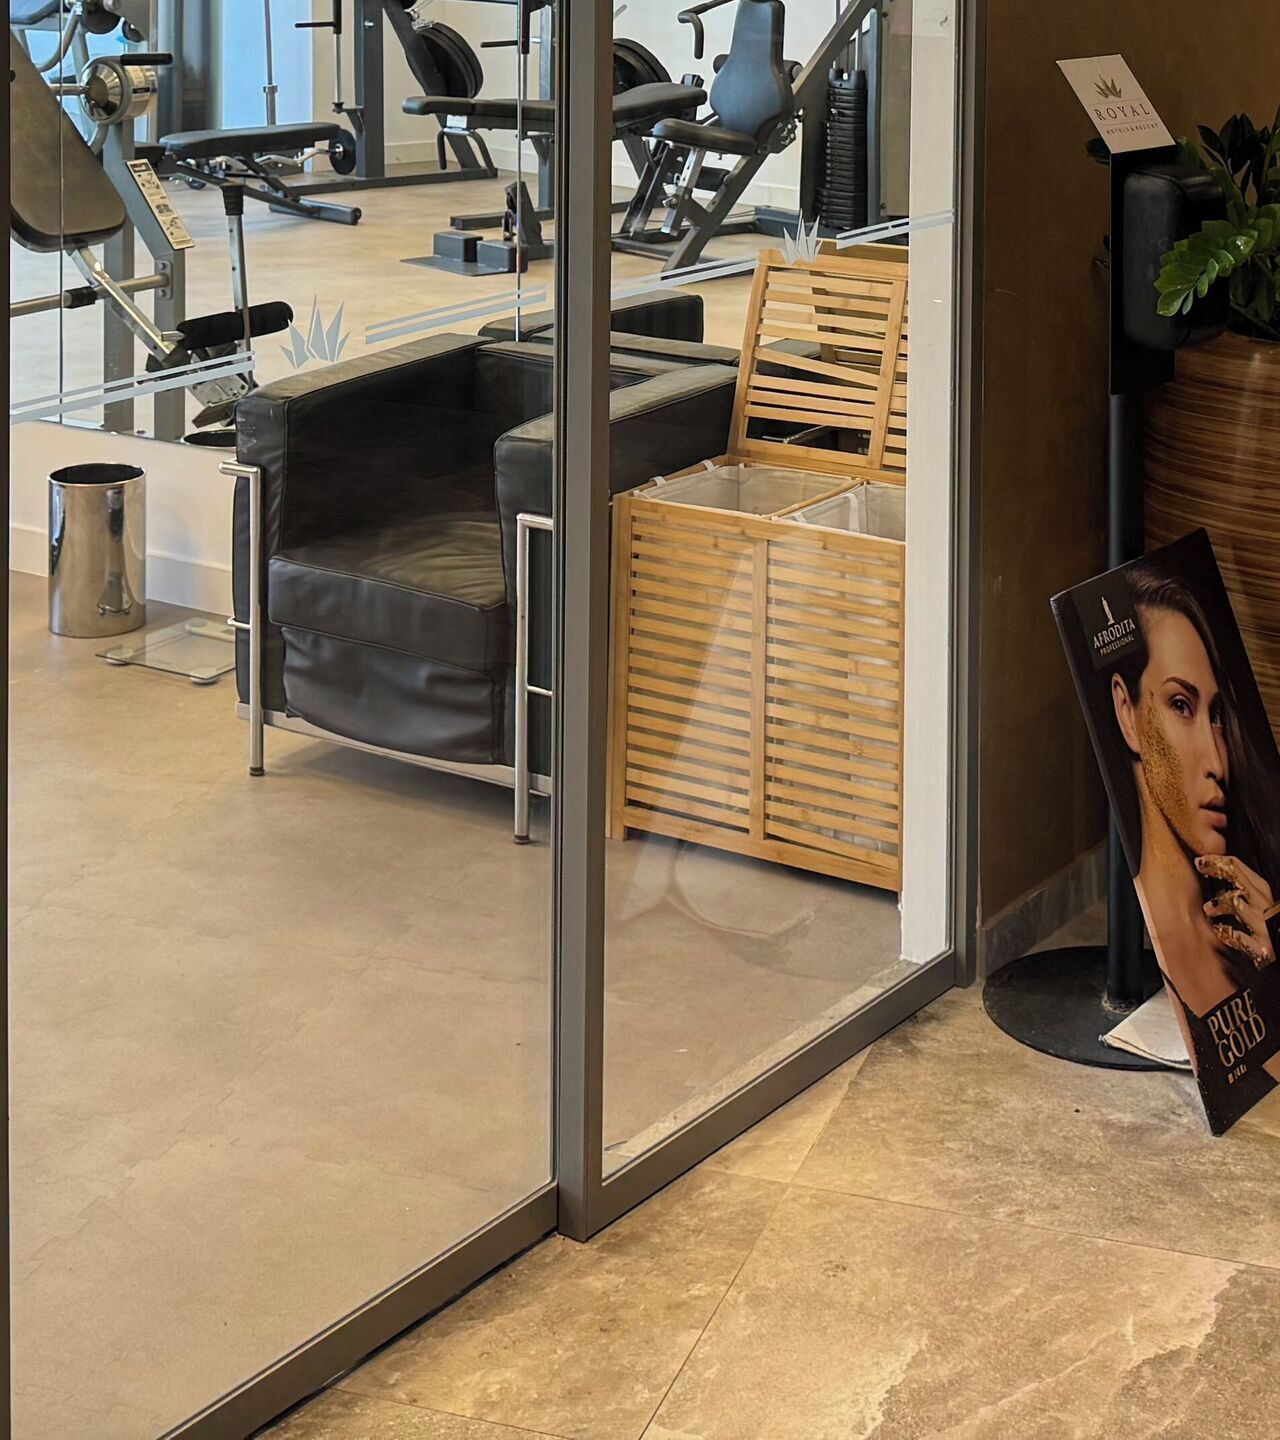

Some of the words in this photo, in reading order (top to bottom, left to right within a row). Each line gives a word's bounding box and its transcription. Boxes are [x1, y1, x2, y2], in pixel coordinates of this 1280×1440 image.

[1094, 103, 1150, 121] ROYAL
[1093, 618, 1136, 649] AFRODITA
[1100, 634, 1134, 656] PROFESSIONAL
[1207, 988, 1257, 1045] PURE
[1218, 1013, 1266, 1067] GOLD
